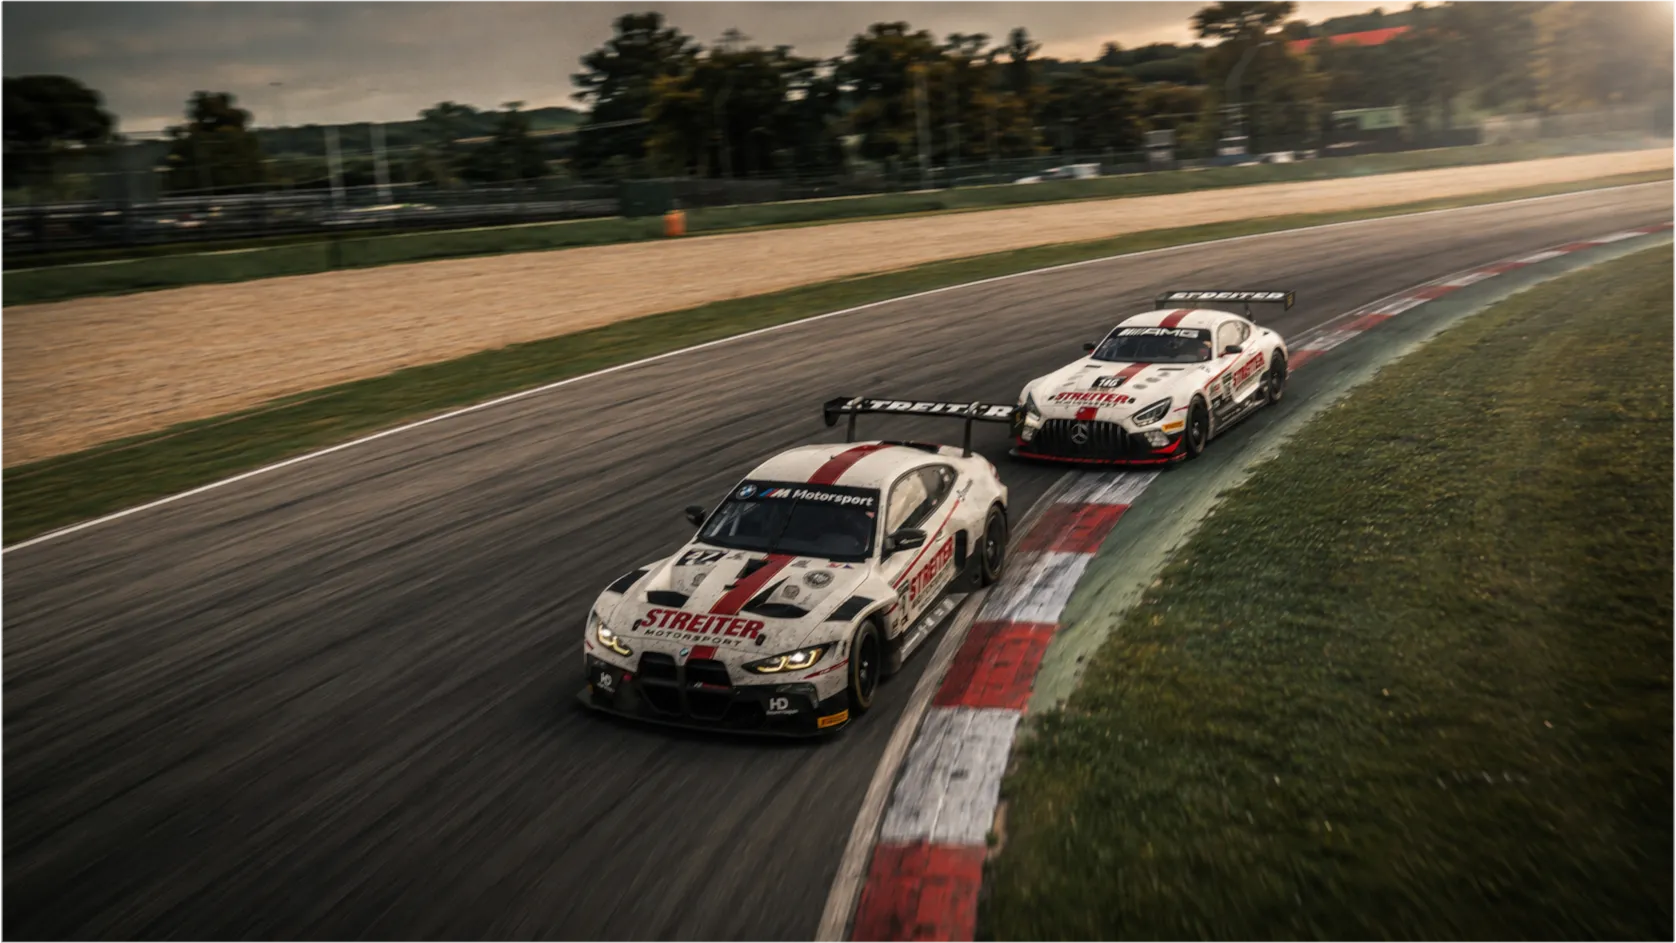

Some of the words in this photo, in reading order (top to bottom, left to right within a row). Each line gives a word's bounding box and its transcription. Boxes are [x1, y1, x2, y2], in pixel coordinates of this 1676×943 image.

[1140, 327, 1200, 339] AMG
[792, 488, 874, 506] Motorsport
[641, 608, 764, 639] STREITER
[644, 629, 742, 646] MOTORSPORT
[769, 696, 789, 711] HD
